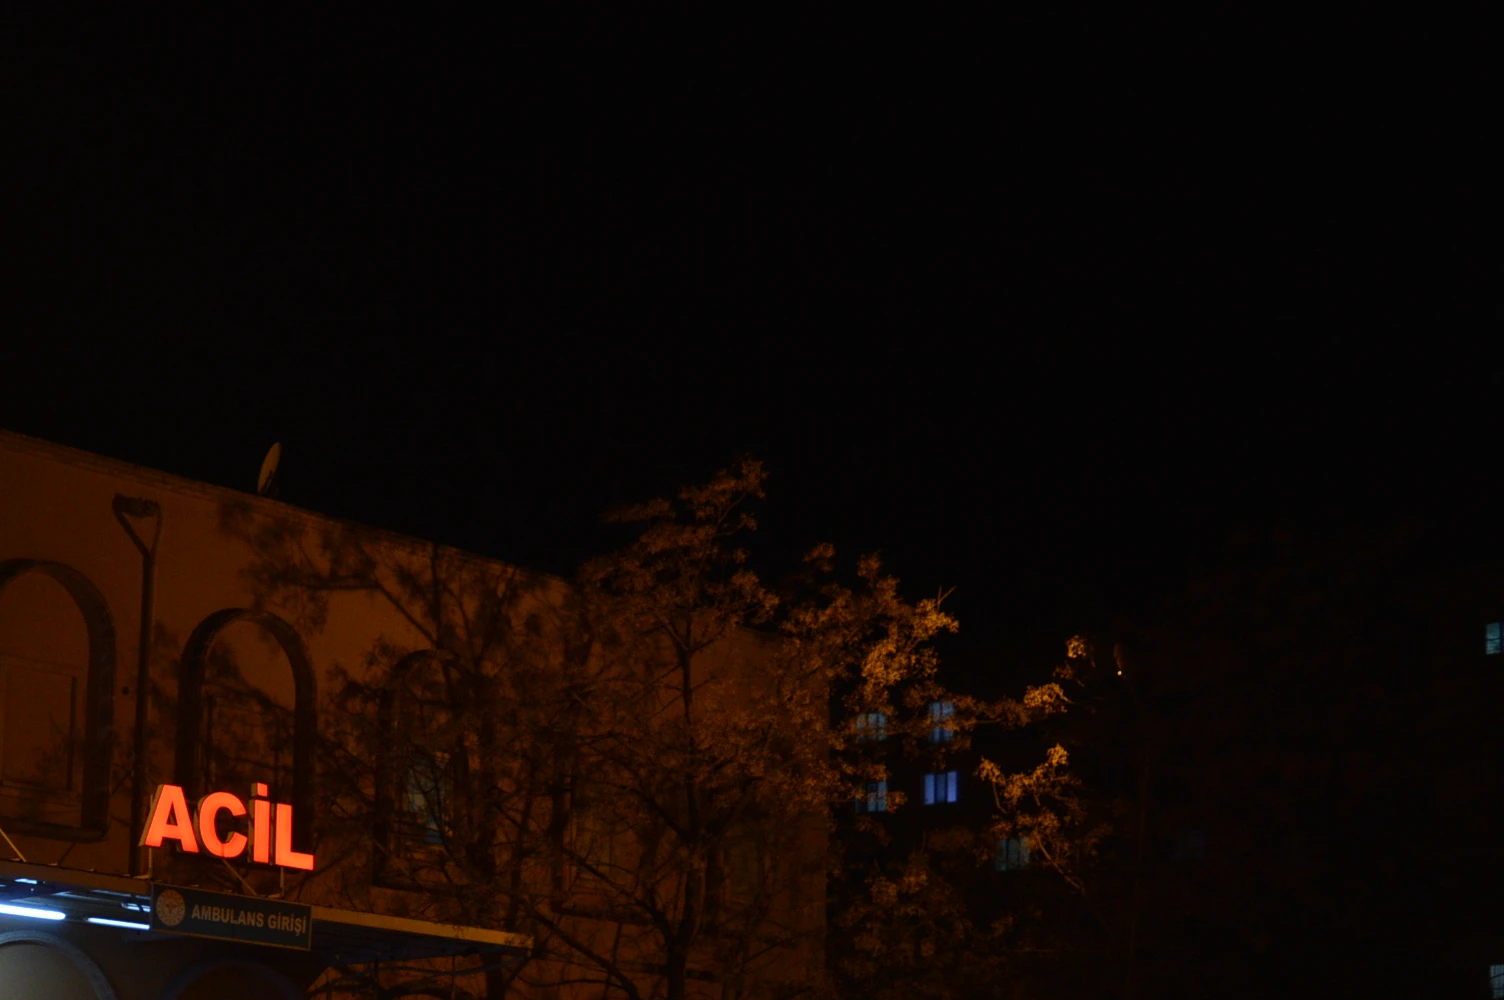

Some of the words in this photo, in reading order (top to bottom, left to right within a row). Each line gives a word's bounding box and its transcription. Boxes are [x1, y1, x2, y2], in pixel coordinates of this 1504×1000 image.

[142, 781, 315, 871] ACİL
[191, 903, 265, 929] AMBULANS
[267, 911, 307, 937] GİRİŞİ
